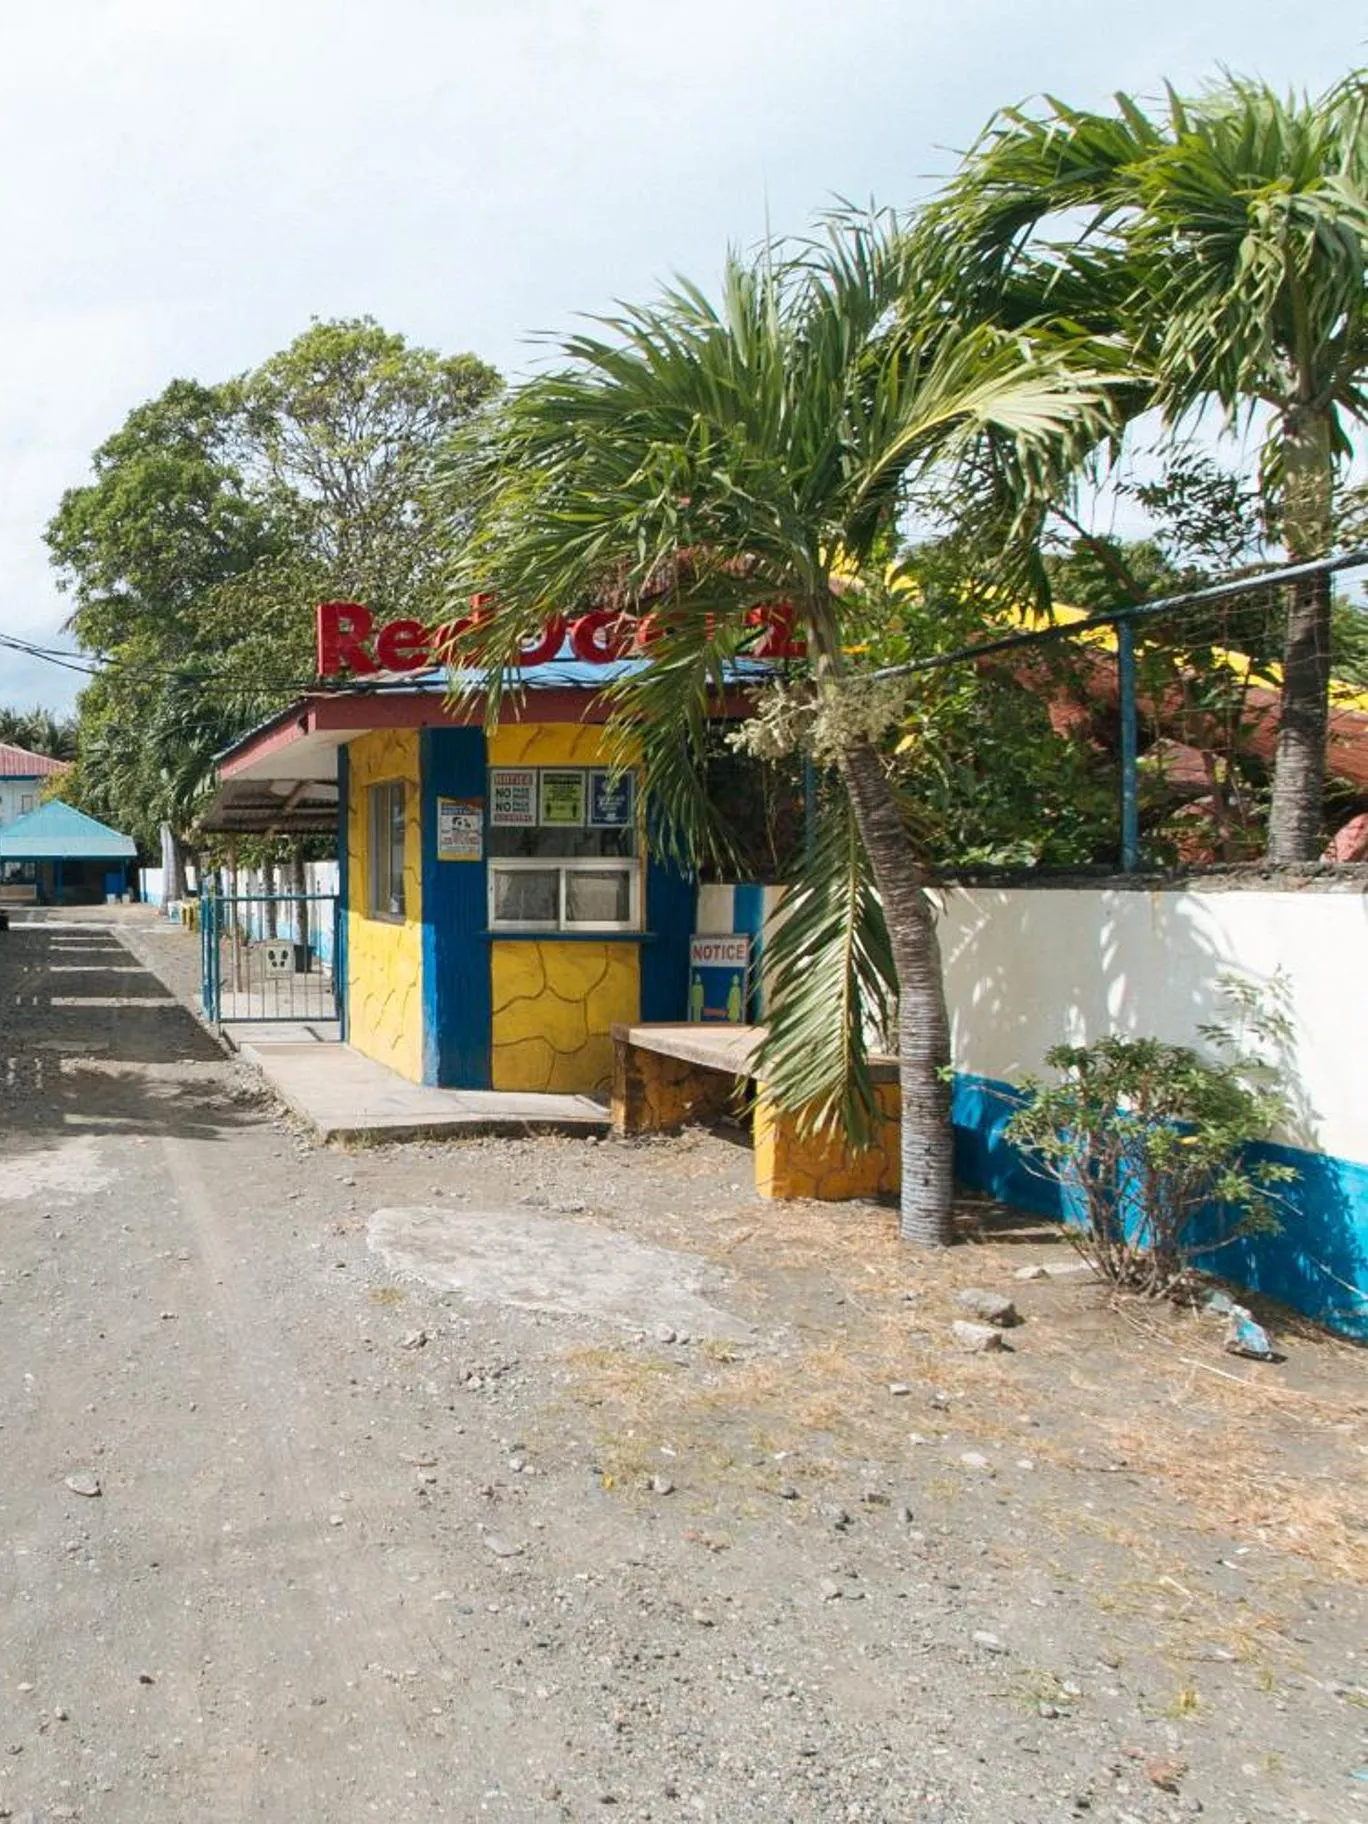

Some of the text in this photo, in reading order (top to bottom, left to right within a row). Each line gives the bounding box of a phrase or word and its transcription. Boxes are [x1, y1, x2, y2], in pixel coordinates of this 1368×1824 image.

[496, 787, 511, 798] NO
[496, 802, 511, 812] NO
[693, 944, 745, 960] NOTICE
